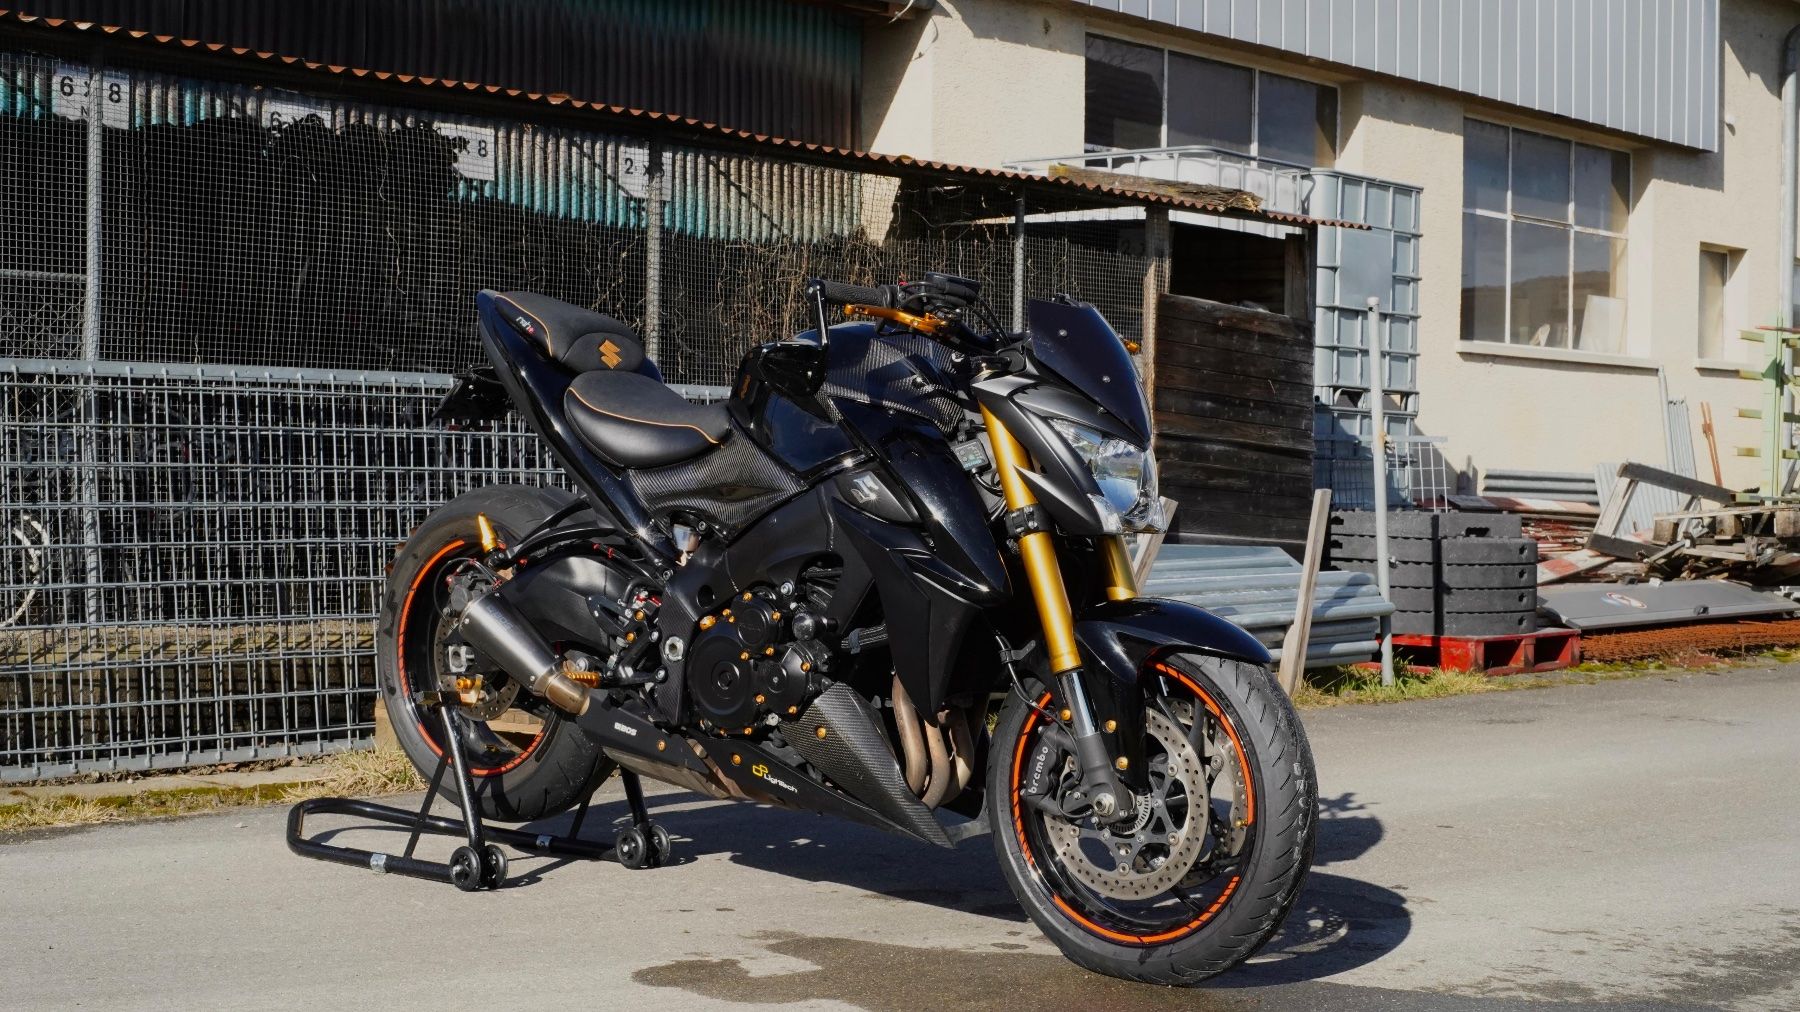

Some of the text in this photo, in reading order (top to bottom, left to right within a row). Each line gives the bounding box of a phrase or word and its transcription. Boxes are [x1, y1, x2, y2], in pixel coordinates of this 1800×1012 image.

[60, 75, 74, 97] 6
[108, 82, 121, 104] 8
[477, 139, 489, 158] 8
[624, 157, 634, 175] 2
[1028, 746, 1049, 794] brembo
